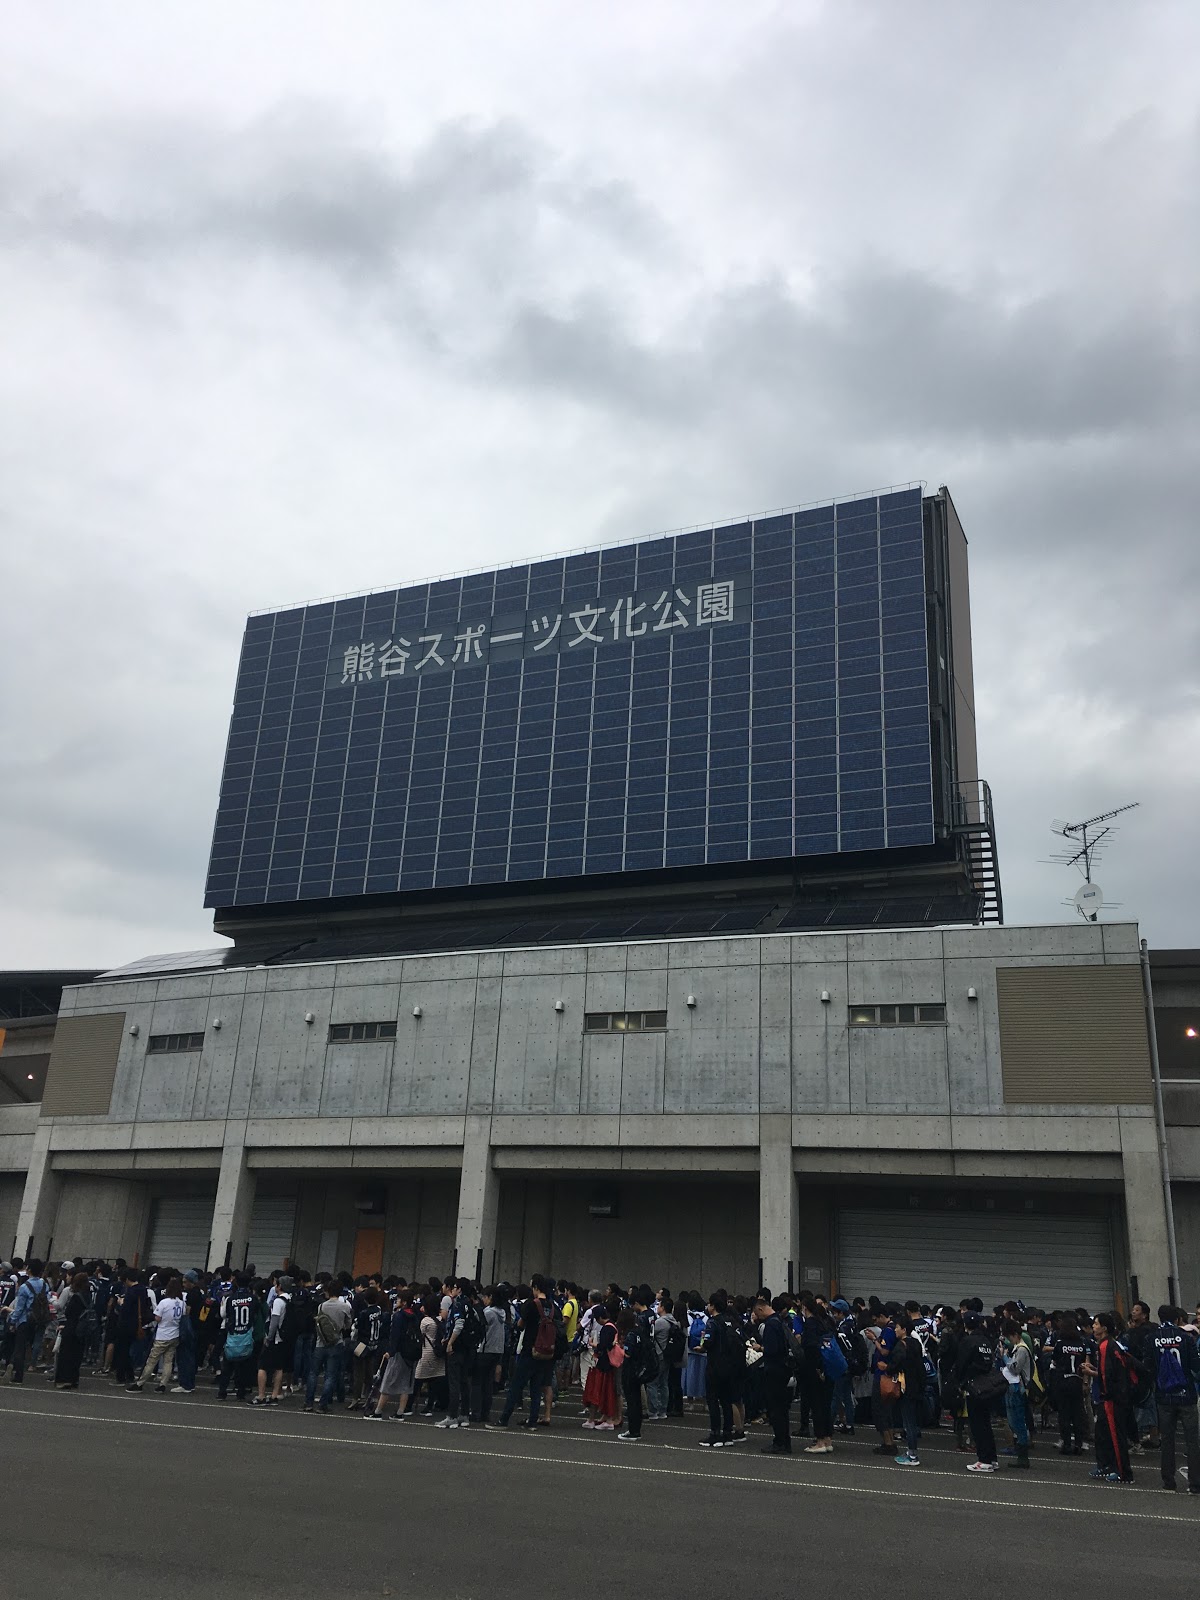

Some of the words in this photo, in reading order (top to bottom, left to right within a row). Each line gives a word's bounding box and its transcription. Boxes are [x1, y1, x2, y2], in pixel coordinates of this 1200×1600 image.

[340, 579, 736, 685] 熊谷スポーツ文化公園
[232, 1297, 253, 1307] ROHTO
[173, 1306, 182, 1318] 10
[234, 1306, 250, 1327] 10
[1154, 1335, 1182, 1348] ROHTO
[1062, 1345, 1084, 1354] ROHTO
[1070, 1354, 1076, 1374] 1
